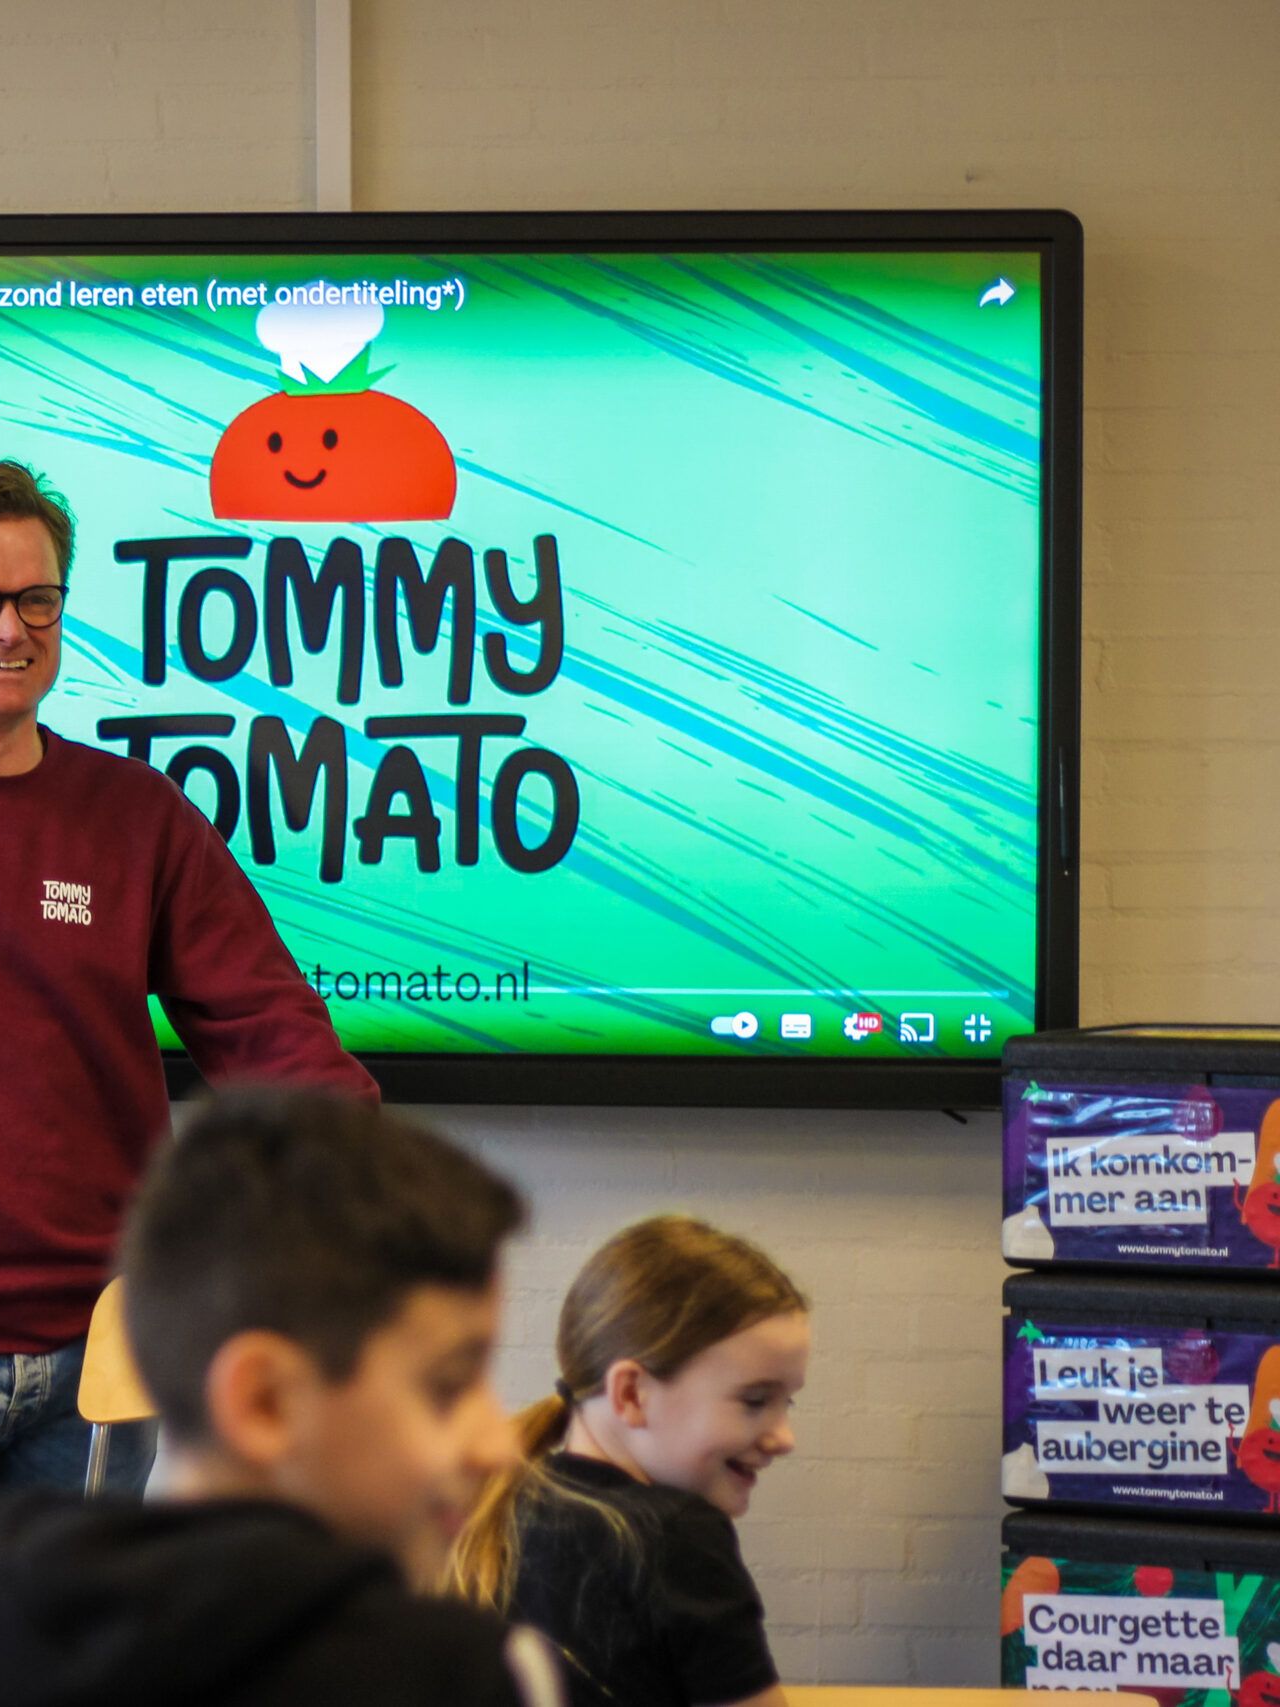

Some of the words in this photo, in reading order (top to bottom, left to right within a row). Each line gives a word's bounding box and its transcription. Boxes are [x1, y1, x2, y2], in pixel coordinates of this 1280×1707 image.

[70, 282, 134, 306] leren
[141, 284, 198, 306] eten
[206, 279, 267, 312] (met
[114, 534, 564, 705] TOMMY
[42, 880, 91, 905] TOMMY
[40, 900, 92, 925] TOMATO
[304, 961, 529, 1002] tomato.nl
[858, 1017, 878, 1029] HD
[1052, 1147, 1082, 1177] Ik
[1090, 1144, 1252, 1177] komkom-
[1054, 1189, 1125, 1214] mer
[1134, 1186, 1203, 1213] aan
[1117, 1243, 1229, 1258] www.tommytomato.nl
[1039, 1357, 1120, 1388] Leuk
[1128, 1357, 1158, 1392] je
[1103, 1400, 1196, 1425] weer
[1205, 1397, 1246, 1425] te
[1041, 1431, 1222, 1470] aubergine
[1112, 1485, 1224, 1501] www.tommytomato.nl
[1028, 1604, 1220, 1645] Courgette
[1042, 1641, 1127, 1672] daar
[1137, 1652, 1234, 1676] maar
